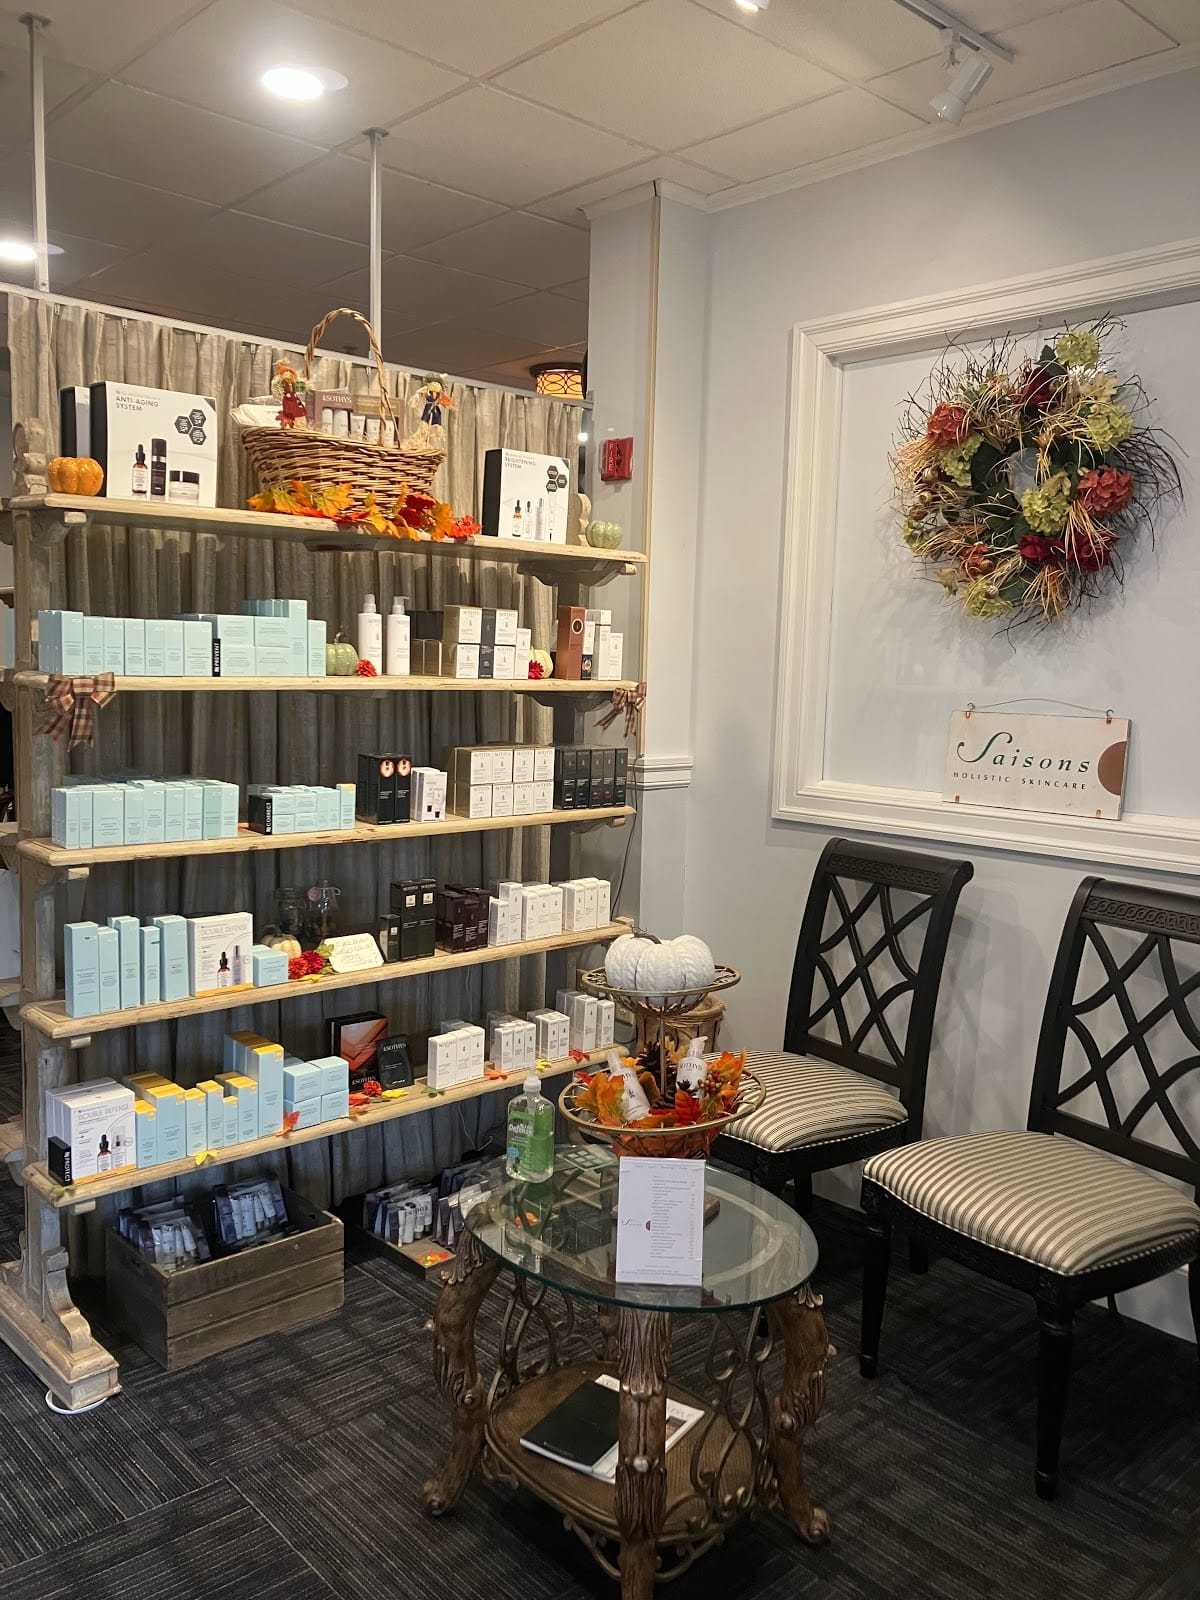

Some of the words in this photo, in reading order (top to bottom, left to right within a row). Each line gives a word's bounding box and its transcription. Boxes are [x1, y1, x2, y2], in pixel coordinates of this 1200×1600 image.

[116, 395, 160, 407] ANTI-AGING
[116, 402, 143, 411] SYSTEM
[956, 731, 1091, 773] Saisons
[953, 771, 1011, 783] HOLISTIC
[1021, 777, 1087, 790] SKINCARE
